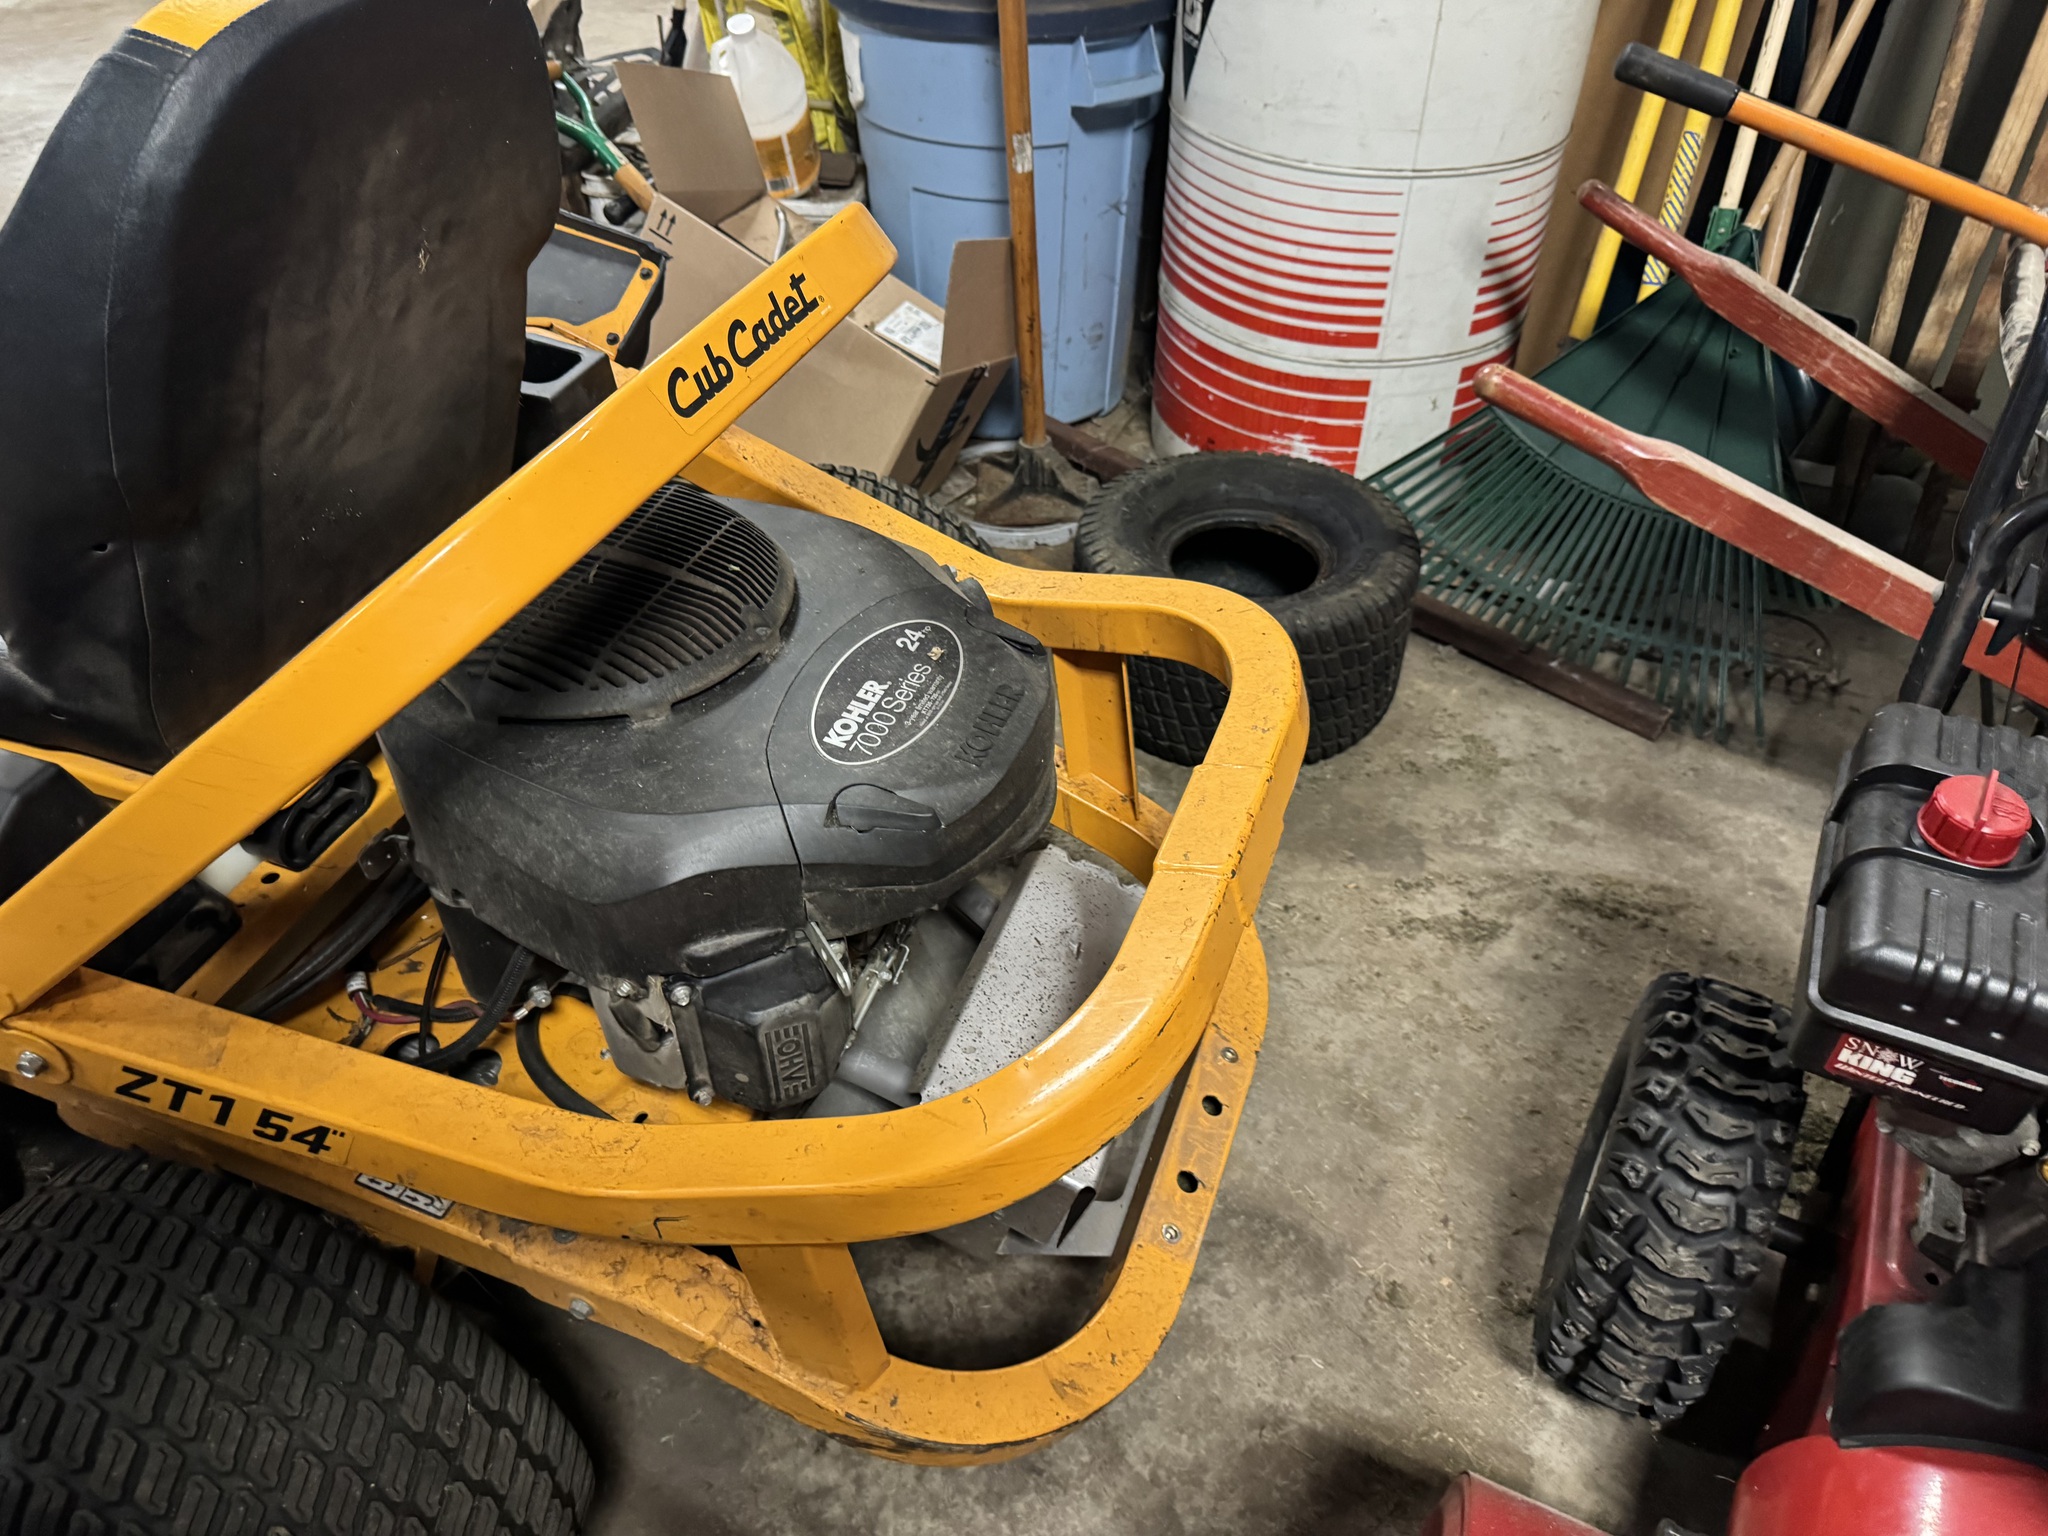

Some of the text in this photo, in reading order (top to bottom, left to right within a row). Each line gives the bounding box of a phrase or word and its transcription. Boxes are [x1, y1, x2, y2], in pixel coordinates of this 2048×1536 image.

[667, 343, 734, 418] Cub
[727, 272, 820, 367] Cadet
[896, 628, 924, 652] 24
[823, 680, 888, 749] KOHLER
[849, 716, 896, 756] 7000
[883, 663, 932, 713] Series
[954, 684, 1026, 768] KOHLER
[1837, 1048, 1918, 1086] KING
[114, 1065, 346, 1155] ZT1 54"
